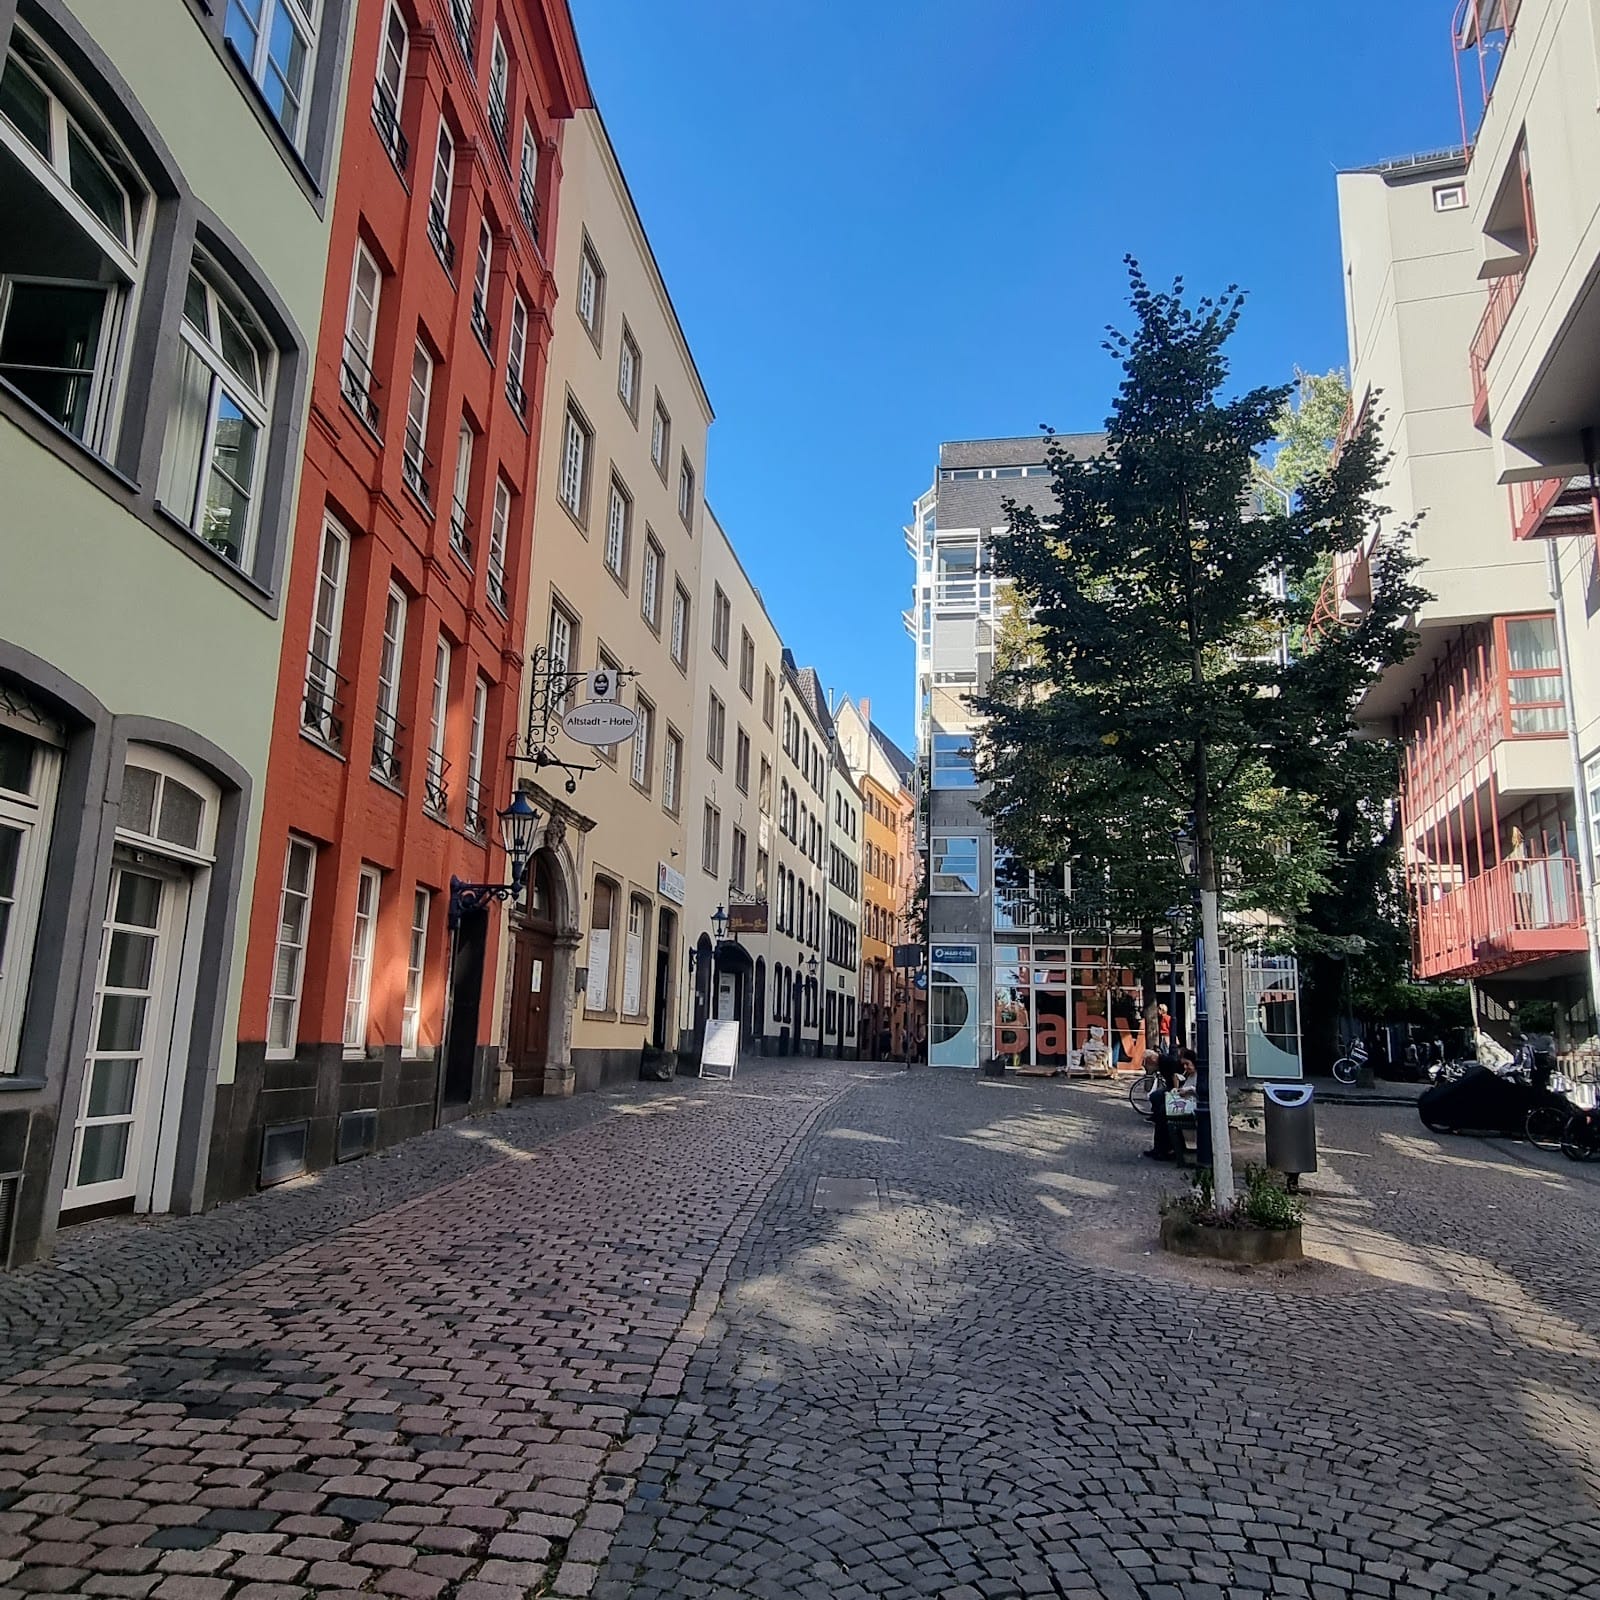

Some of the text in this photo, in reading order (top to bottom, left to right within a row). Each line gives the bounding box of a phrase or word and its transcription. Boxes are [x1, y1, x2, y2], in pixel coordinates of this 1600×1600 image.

[567, 716, 600, 726] Altstadt
[609, 716, 633, 726] Hotel
[995, 1001, 1146, 1071] Baby
